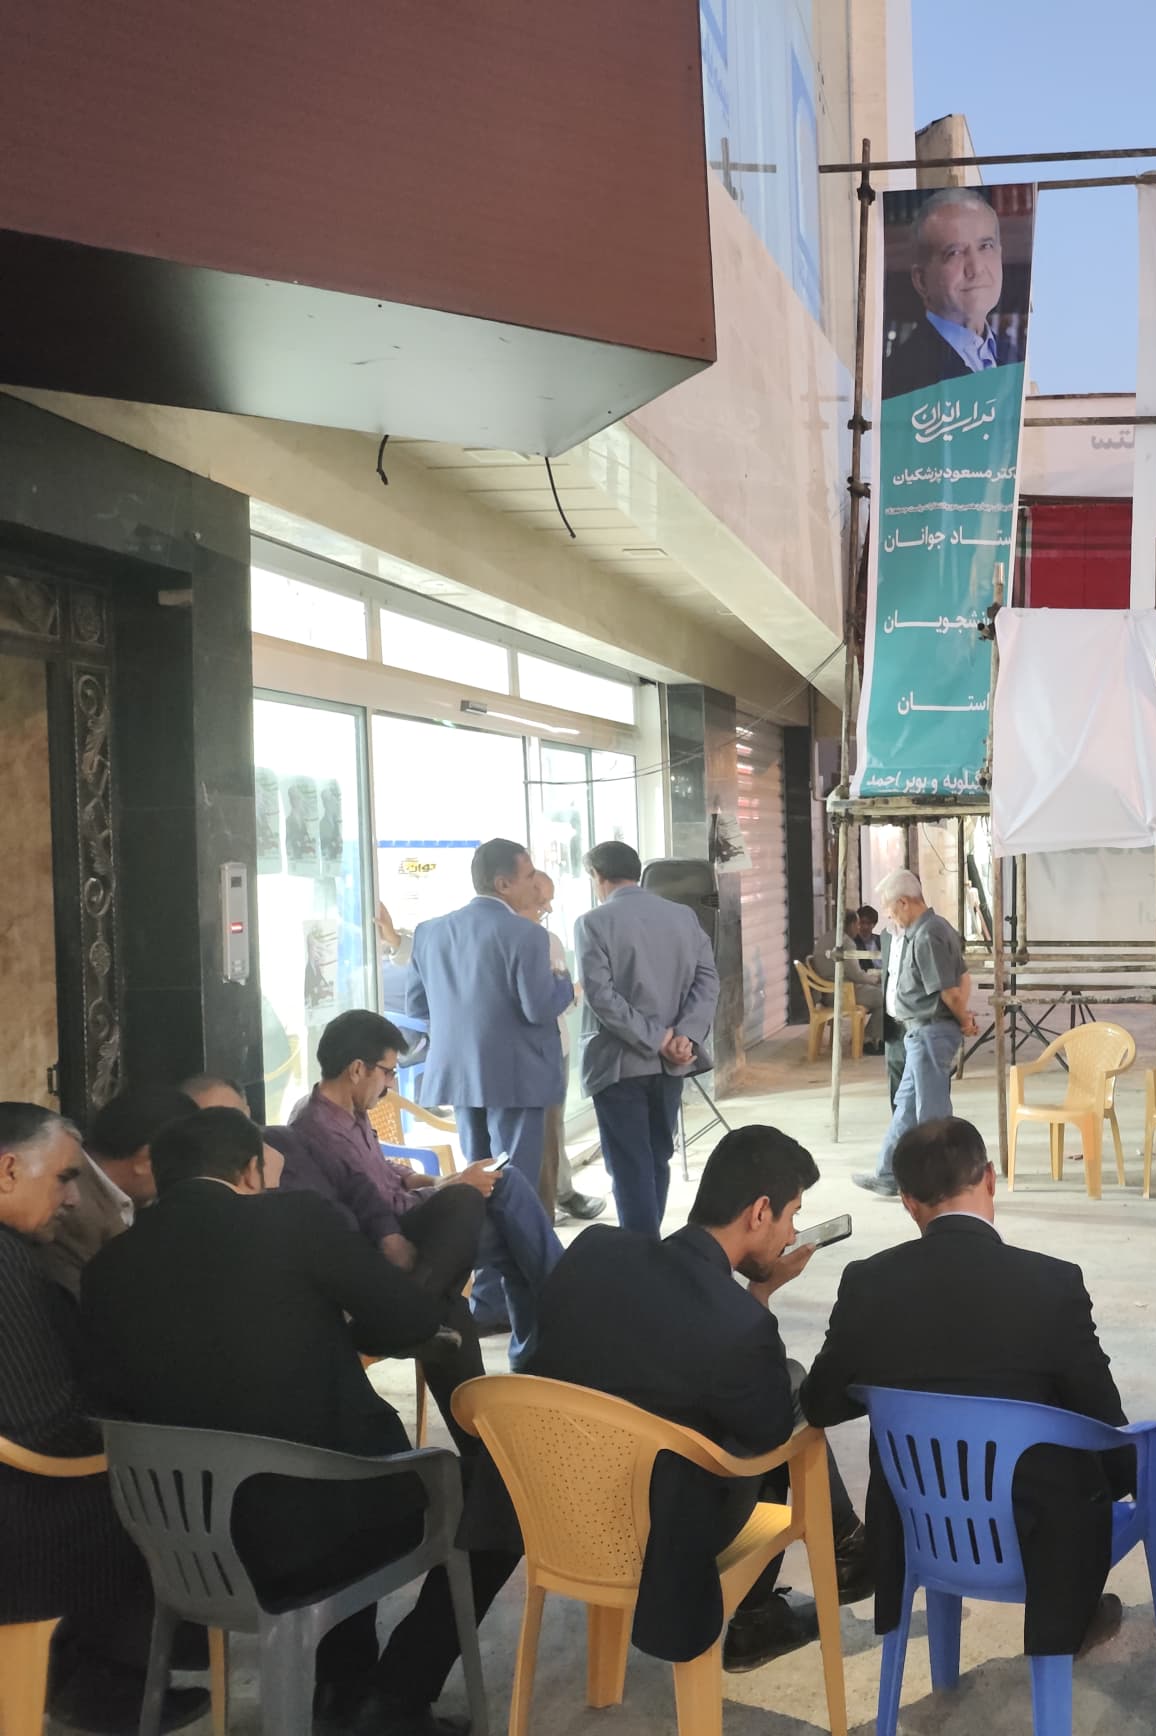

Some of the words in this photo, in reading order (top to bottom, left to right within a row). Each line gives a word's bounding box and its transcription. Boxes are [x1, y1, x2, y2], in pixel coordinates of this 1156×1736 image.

[892, 467, 942, 486] پزشکیان
[943, 467, 992, 483] مسعود
[884, 525, 946, 552] جوانان
[897, 690, 990, 715] استان
[931, 776, 938, 795] و
